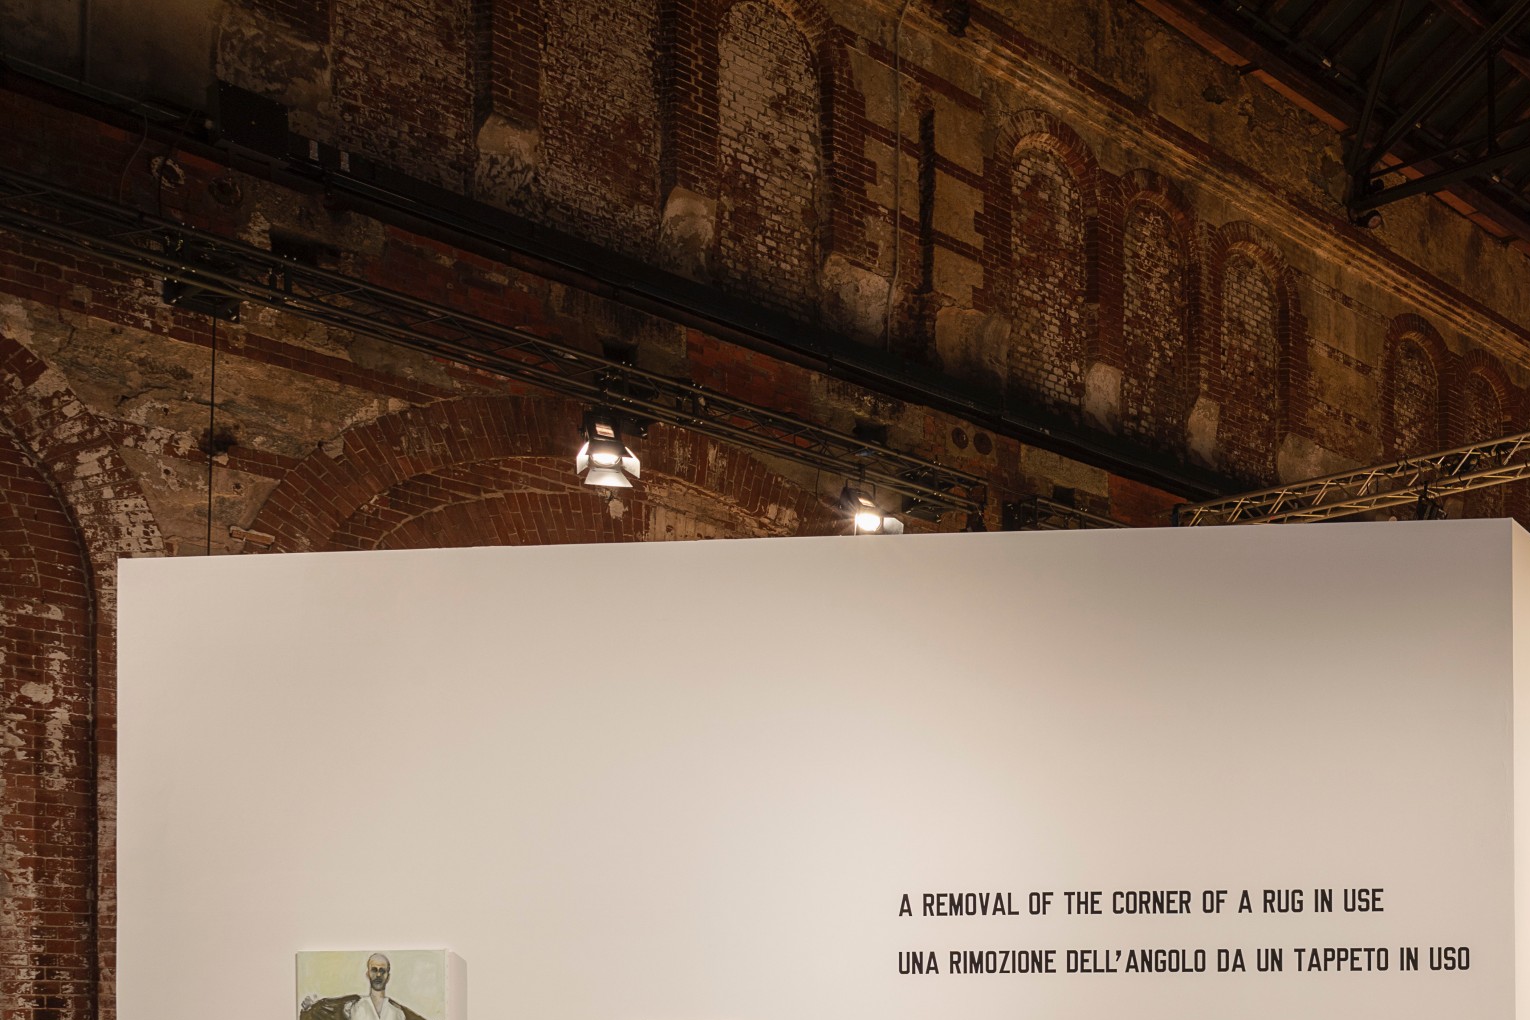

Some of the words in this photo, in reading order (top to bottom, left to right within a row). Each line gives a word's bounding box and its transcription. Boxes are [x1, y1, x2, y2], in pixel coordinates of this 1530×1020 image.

[898, 893, 913, 917] A
[922, 892, 1020, 917] REMOVAL
[1028, 891, 1054, 916] OF
[1063, 891, 1103, 915] THE
[1112, 890, 1192, 915] CORNER
[1202, 889, 1228, 914] OF
[1237, 889, 1253, 914] A
[1263, 889, 1304, 914] RUG
[1314, 888, 1333, 913] IN
[1343, 888, 1384, 913] USE
[898, 951, 940, 975] UNA
[949, 949, 1057, 975] RIMOZIONE
[1217, 948, 1246, 973] DA
[1256, 947, 1283, 972] UN
[1293, 947, 1389, 972] TAPPETO
[1399, 946, 1419, 971] IN
[1429, 946, 1470, 971] USO
